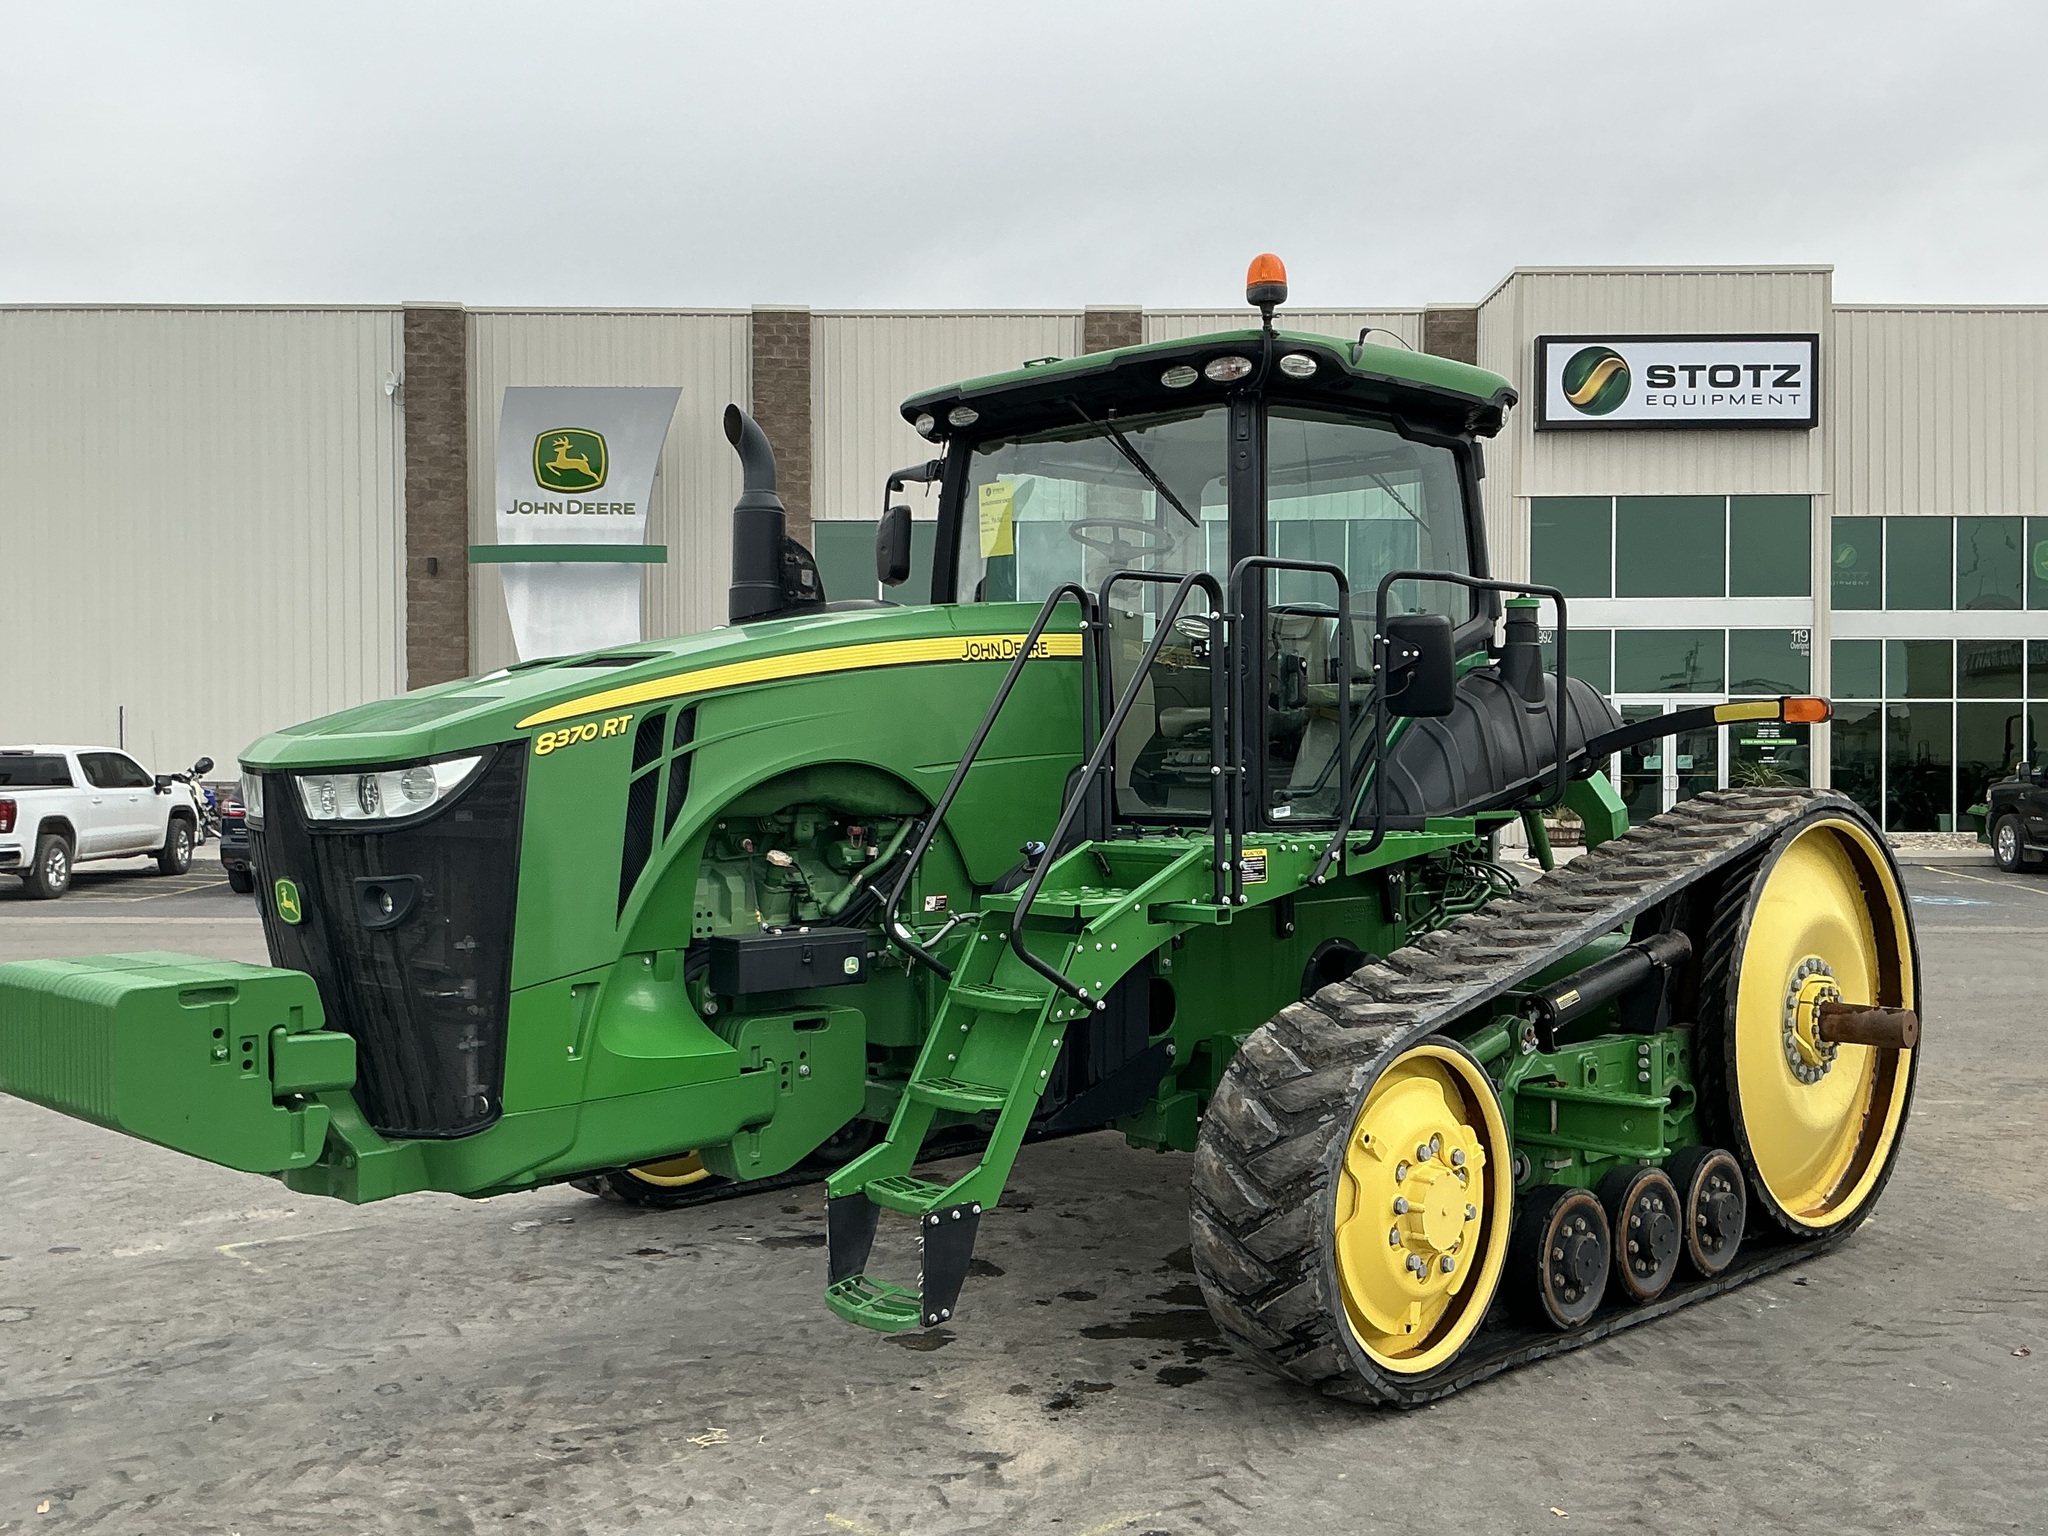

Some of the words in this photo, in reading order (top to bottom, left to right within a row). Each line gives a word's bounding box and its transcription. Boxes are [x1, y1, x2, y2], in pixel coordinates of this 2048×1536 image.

[1646, 364, 1801, 389] STOTZ
[1646, 394, 1801, 408] EQUIPMENT
[506, 499, 563, 515] JOHN
[567, 499, 636, 515] DEERE
[1791, 629, 1808, 642] 119
[961, 640, 1001, 659] JOHN
[1002, 639, 1049, 656] DERE
[534, 722, 600, 756] 8370
[601, 713, 635, 740] RT
